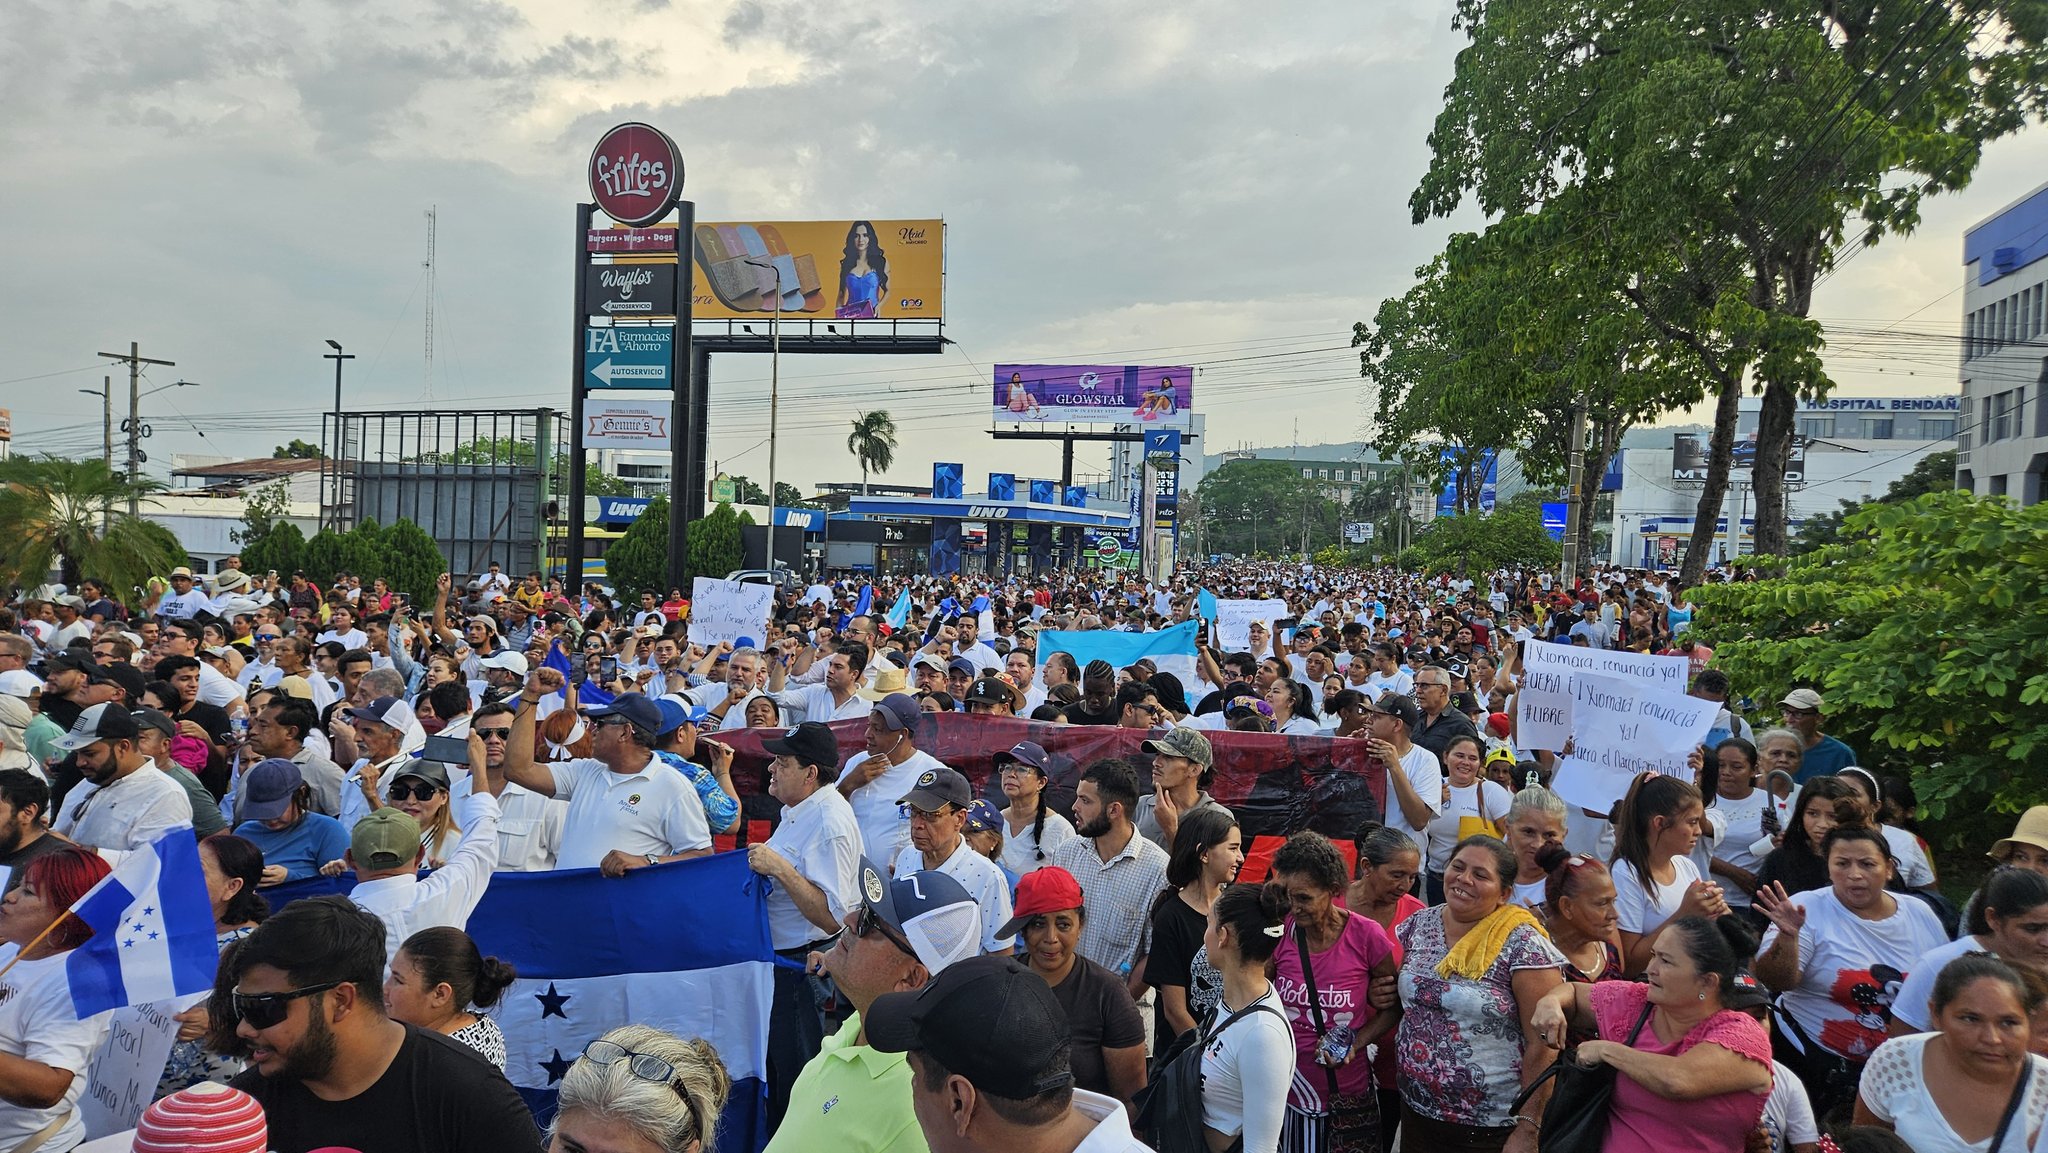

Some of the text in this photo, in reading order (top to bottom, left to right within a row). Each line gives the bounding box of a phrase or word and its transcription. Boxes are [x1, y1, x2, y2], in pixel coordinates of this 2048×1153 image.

[588, 233, 673, 243] Burgers Wings Dogs
[587, 328, 621, 353] FA
[619, 331, 671, 342] Farmacias
[624, 341, 661, 351] Ahorro
[611, 368, 663, 376] AUTOSERVICIO
[1056, 394, 1126, 405] GLOWSTAR
[1806, 399, 1885, 410] HOSPITAL
[967, 505, 1009, 519] UNO
[785, 510, 812, 529] UNO
[1524, 704, 1566, 726] #LIBRE
[1602, 749, 1610, 767] el
[1278, 976, 1355, 1009] Hollster
